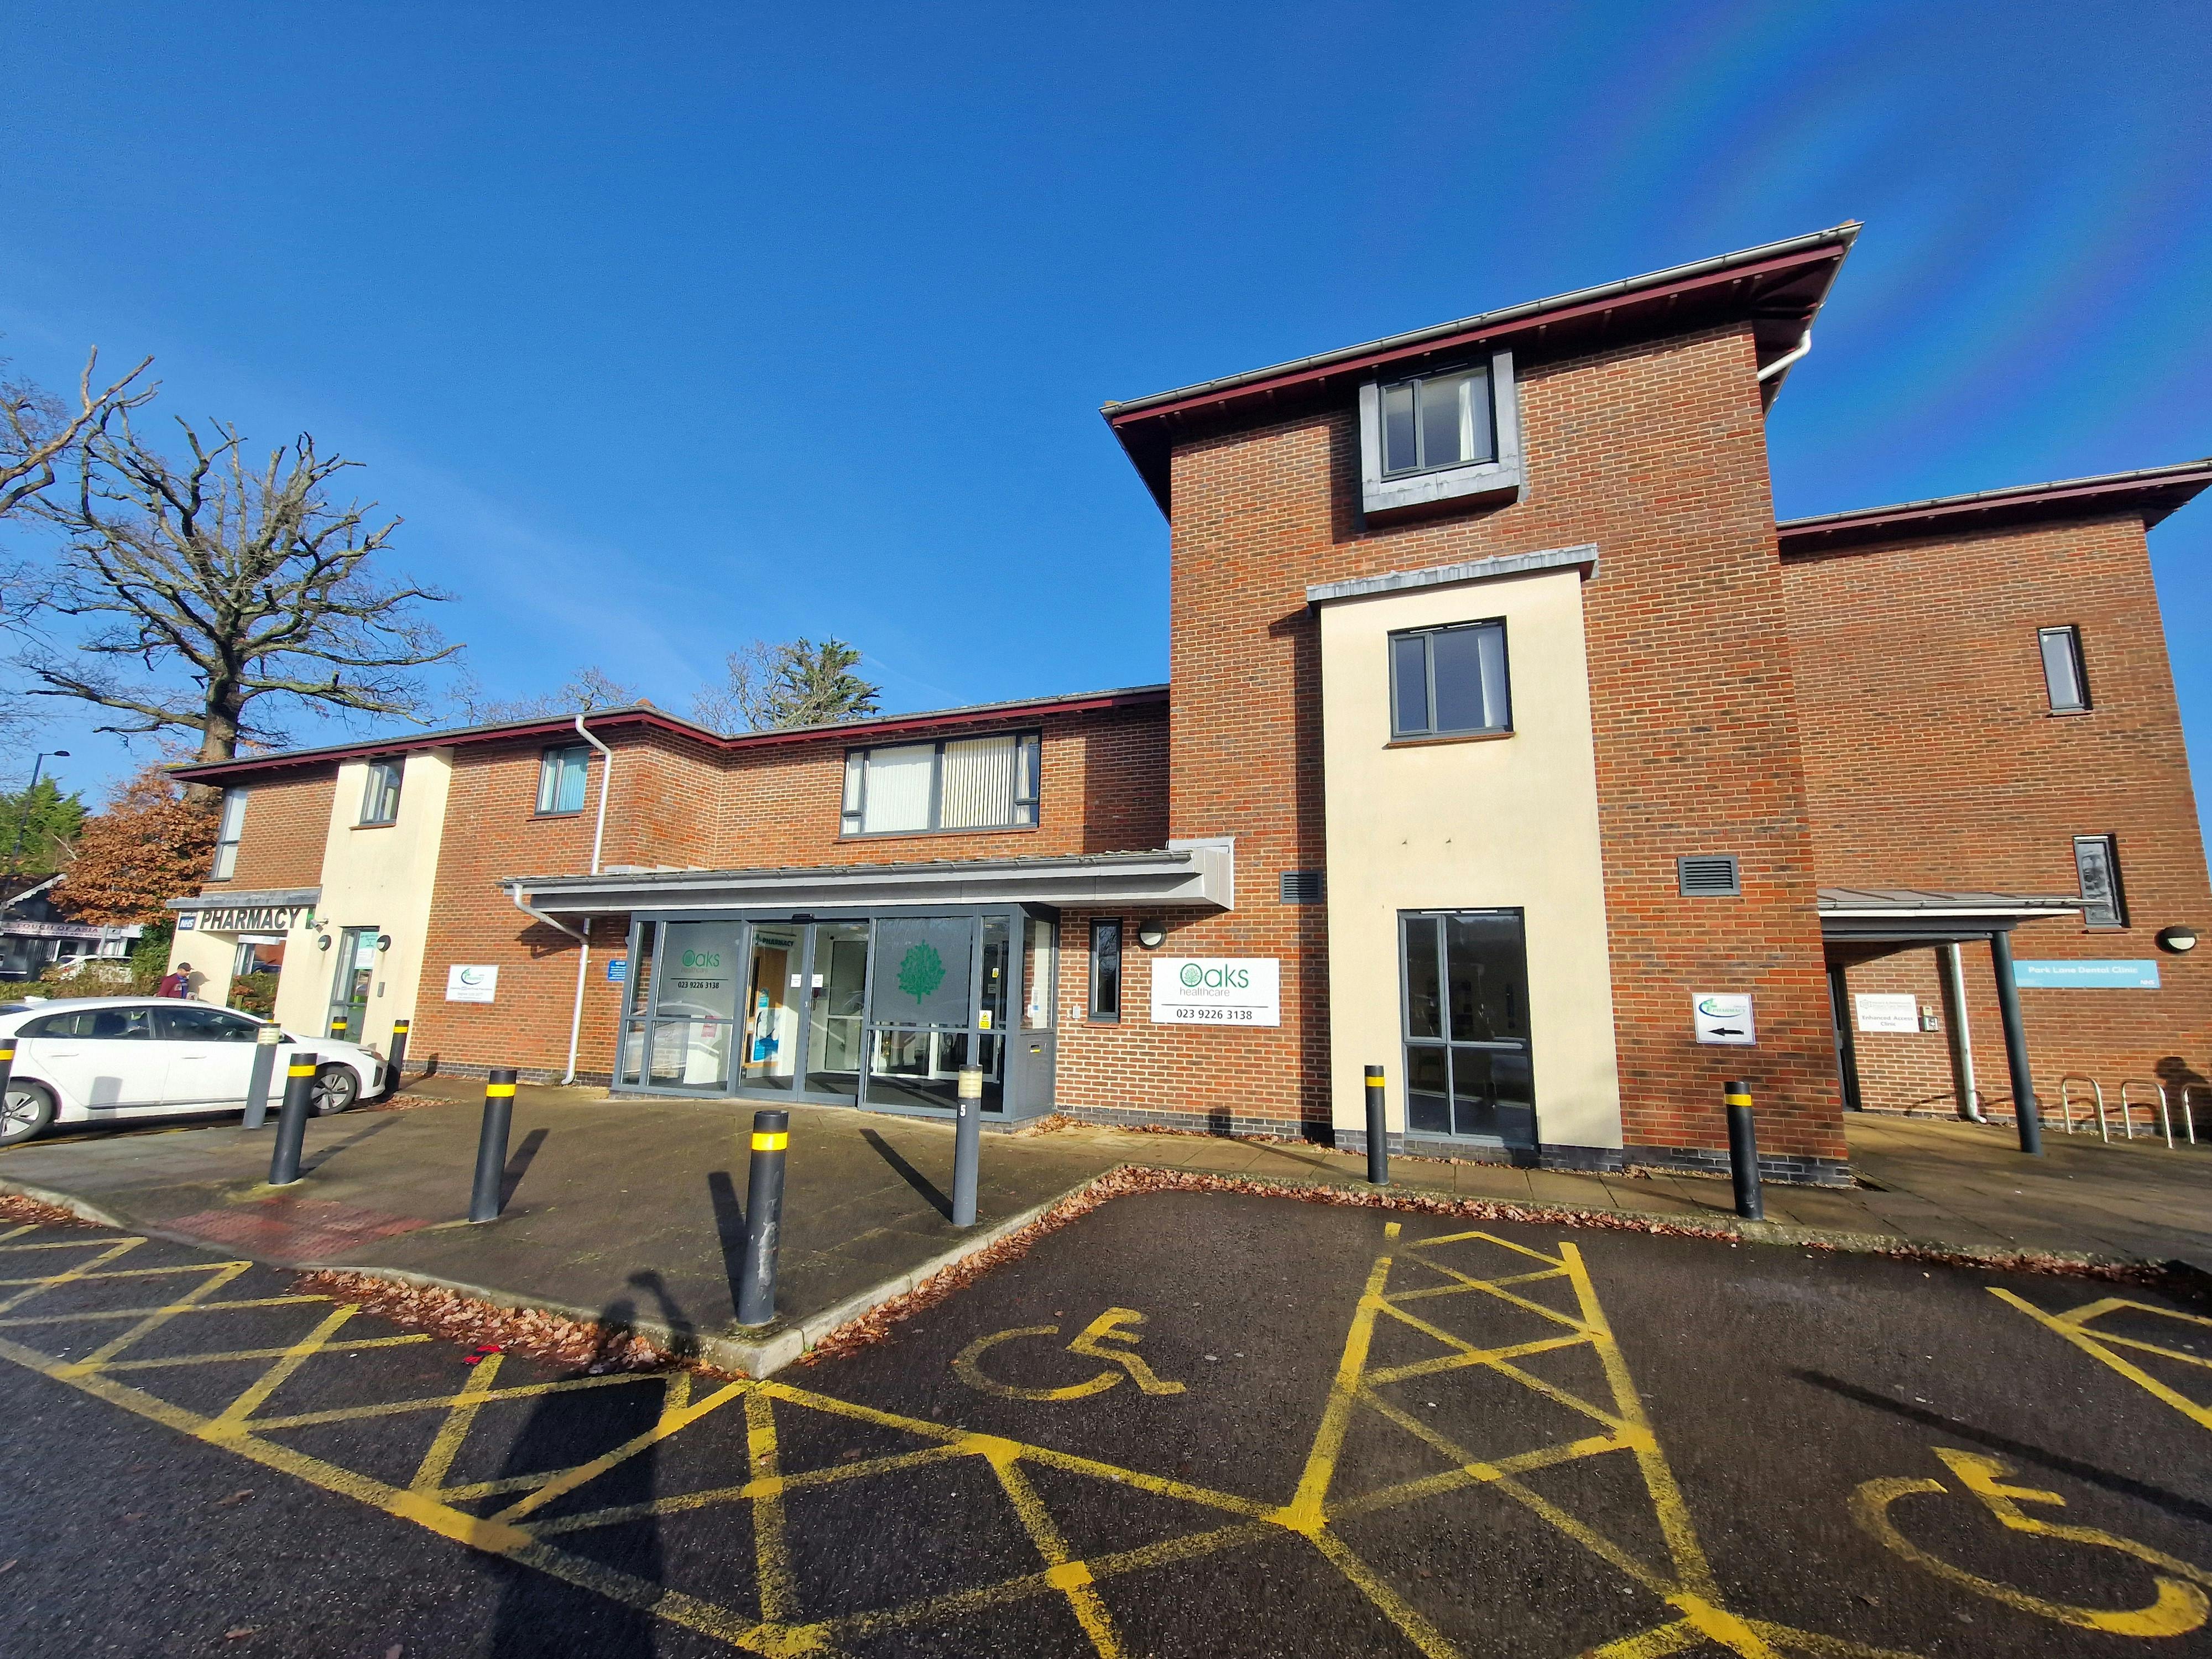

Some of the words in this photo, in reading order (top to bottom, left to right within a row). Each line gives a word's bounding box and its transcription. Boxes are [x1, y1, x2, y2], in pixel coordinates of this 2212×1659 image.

[180, 919, 194, 928] NHS
[200, 908, 302, 929] PHARMACY
[762, 937, 794, 947] PHARMACY
[682, 950, 720, 967] Oaks
[1180, 963, 1249, 988] Oaks
[1180, 987, 1230, 997] healthcare
[1177, 1009, 1194, 1018] 023
[1198, 1009, 1223, 1019] 9226
[1227, 1010, 1252, 1020] 3138
[960, 1104, 966, 1117] 5
